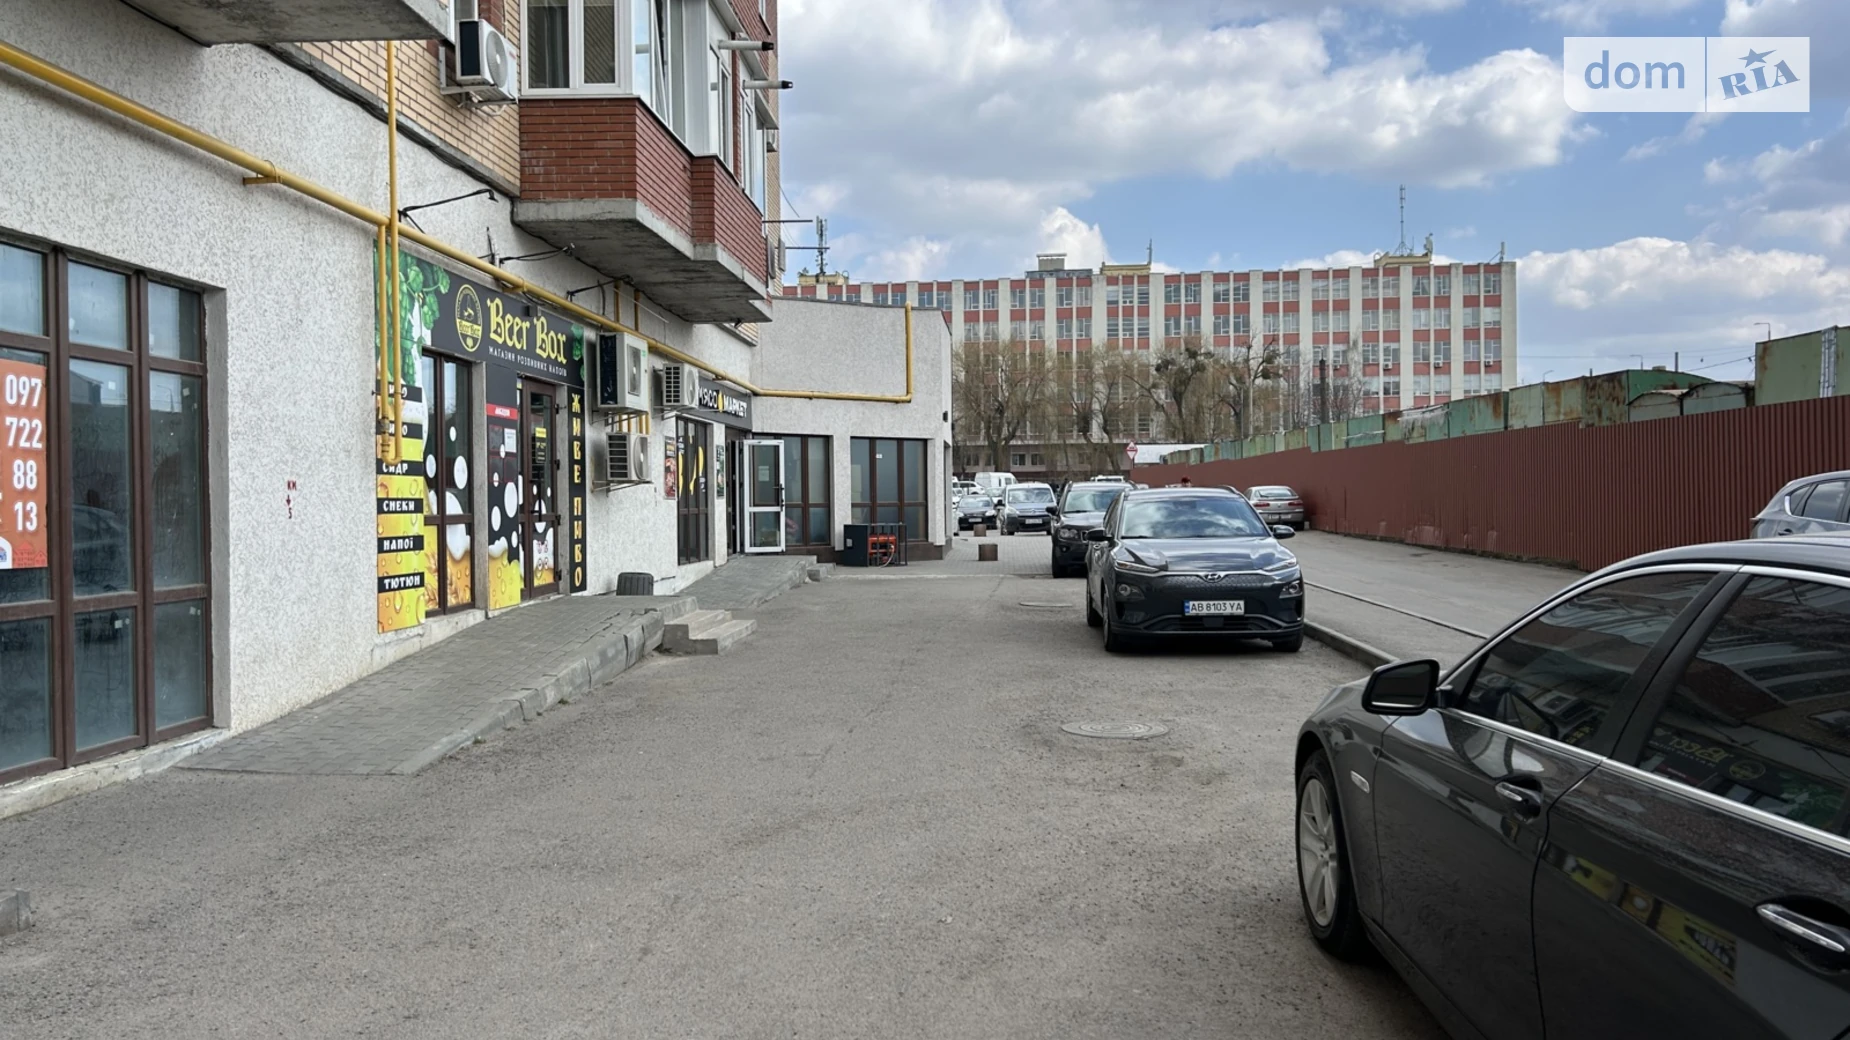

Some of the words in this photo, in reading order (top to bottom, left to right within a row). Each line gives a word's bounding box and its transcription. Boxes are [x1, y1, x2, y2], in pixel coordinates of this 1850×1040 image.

[486, 297, 530, 350] Beer
[533, 316, 567, 365] Box
[488, 346, 515, 361] МАГАЗИН
[5, 374, 42, 407] 097
[723, 394, 747, 418] МАРКЕТ
[5, 416, 42, 449] 722
[571, 393, 582, 484] ЖИВЕ
[13, 459, 37, 490] 88
[14, 501, 37, 532] 13
[383, 500, 415, 511] СНЕКИ
[383, 537, 413, 551] НАПОЇ
[573, 496, 583, 587] ПИВО
[384, 574, 420, 590] ТЮТЮН
[1190, 602, 1204, 612] AB
[1205, 602, 1228, 612] 8103
[1229, 602, 1243, 611] YA
